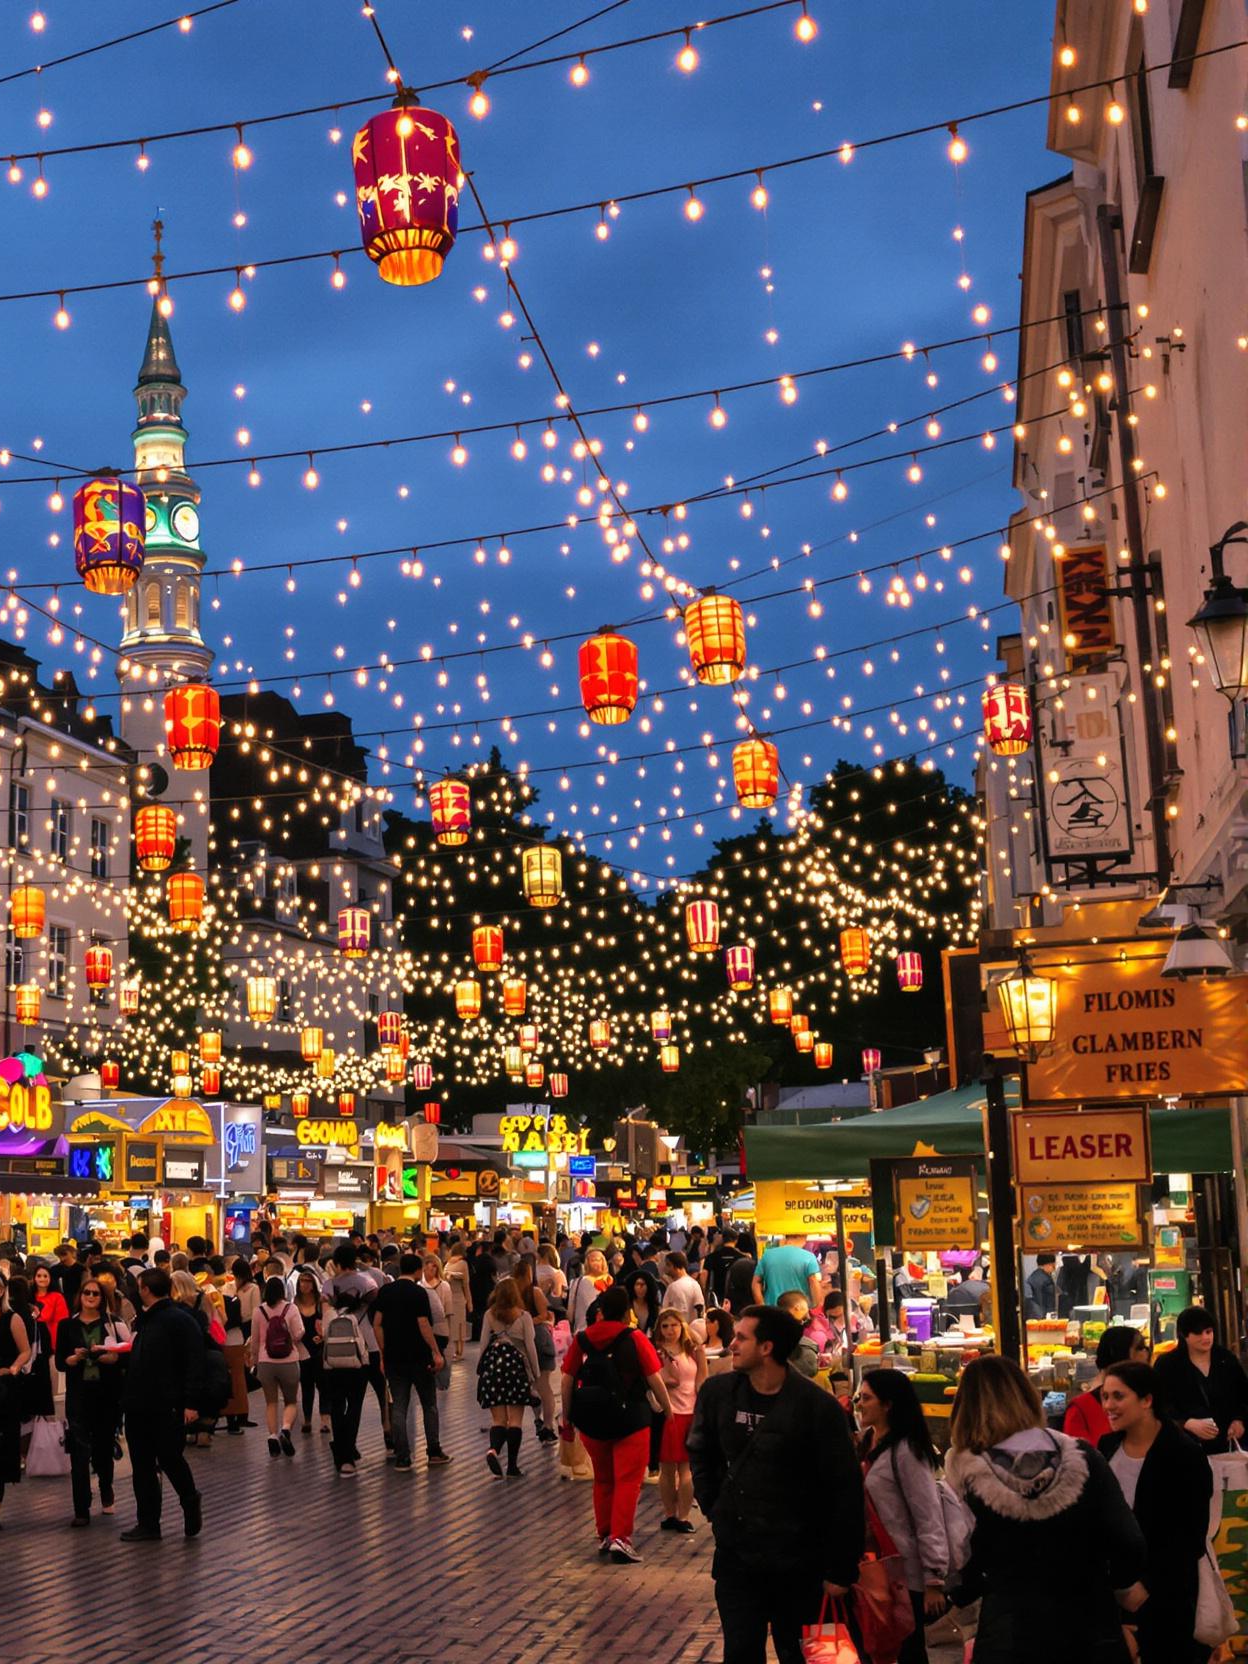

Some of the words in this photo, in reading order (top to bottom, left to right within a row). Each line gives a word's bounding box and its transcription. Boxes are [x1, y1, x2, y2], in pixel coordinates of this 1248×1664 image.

[1083, 988, 1175, 1012] FILOMIS
[1072, 1028, 1203, 1055] GLAMBERN
[1105, 1061, 1170, 1083] FRIES
[1029, 1133, 1133, 1160] LEASER
